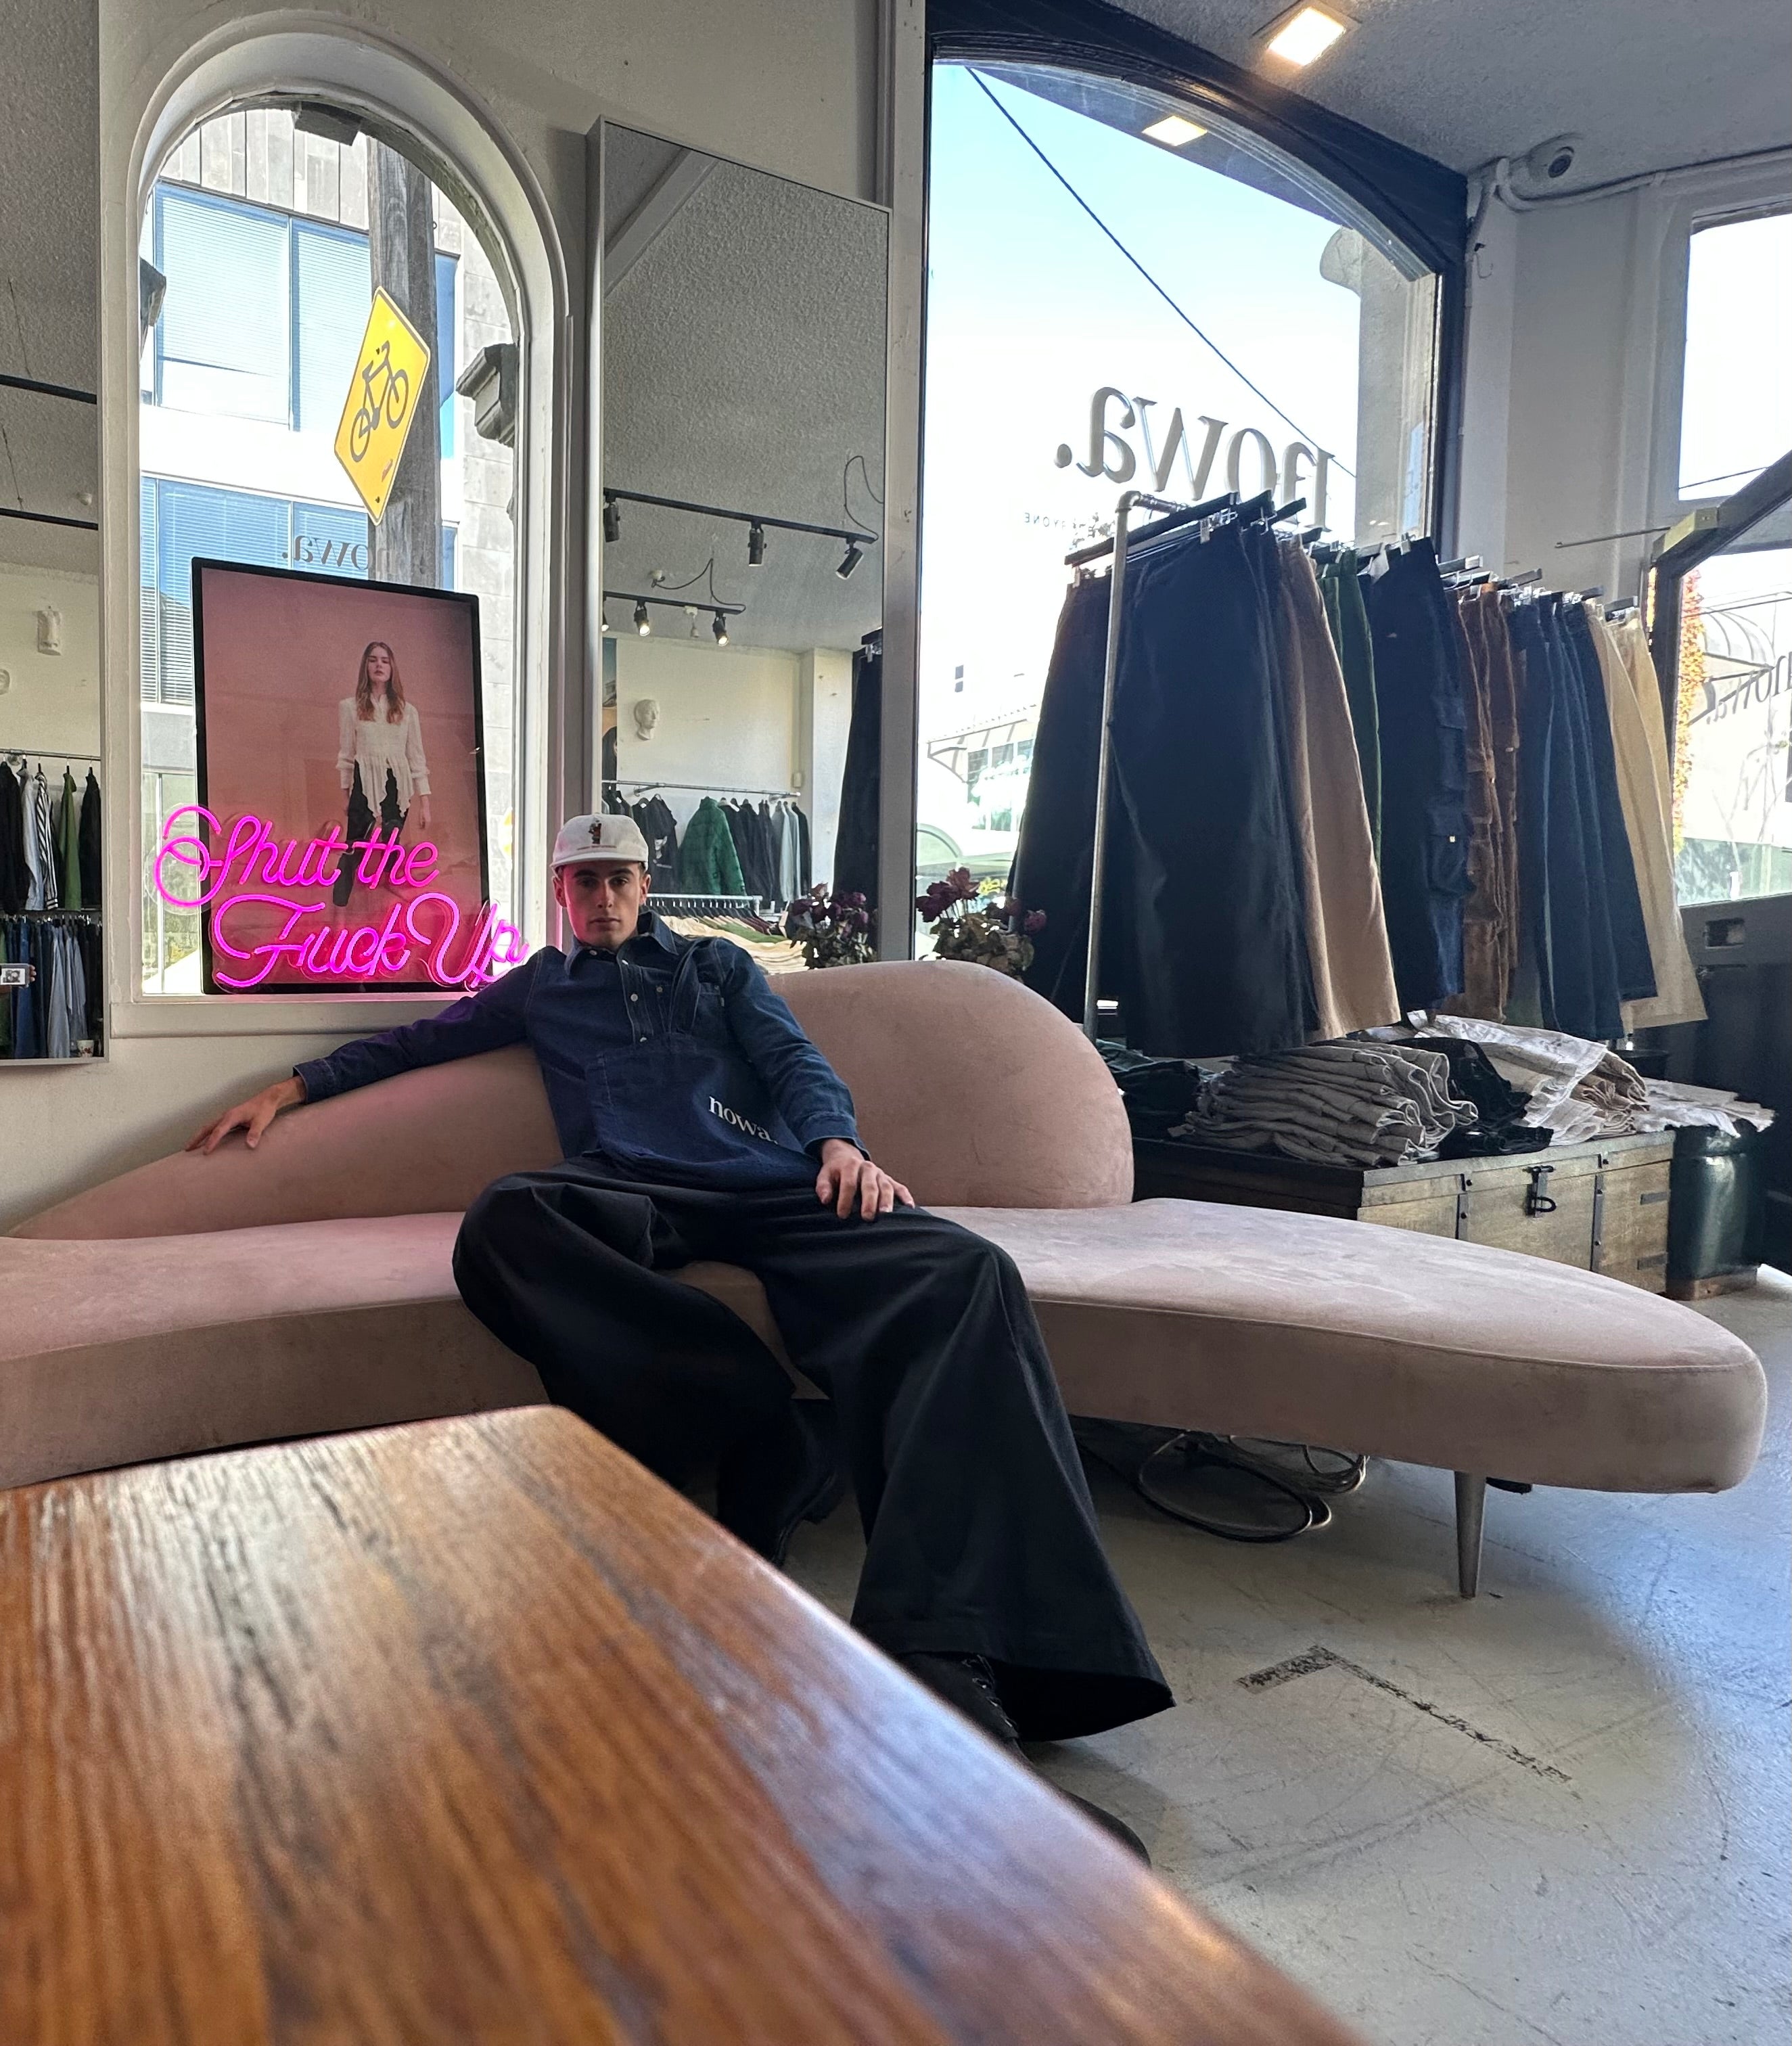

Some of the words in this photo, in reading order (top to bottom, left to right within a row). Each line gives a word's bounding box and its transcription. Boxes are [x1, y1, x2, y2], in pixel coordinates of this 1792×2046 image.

[154, 804, 348, 908] Shut
[352, 826, 439, 890] the
[213, 893, 411, 987] Fuck
[406, 892, 530, 988] Up
[708, 1095, 779, 1145] nowa.
